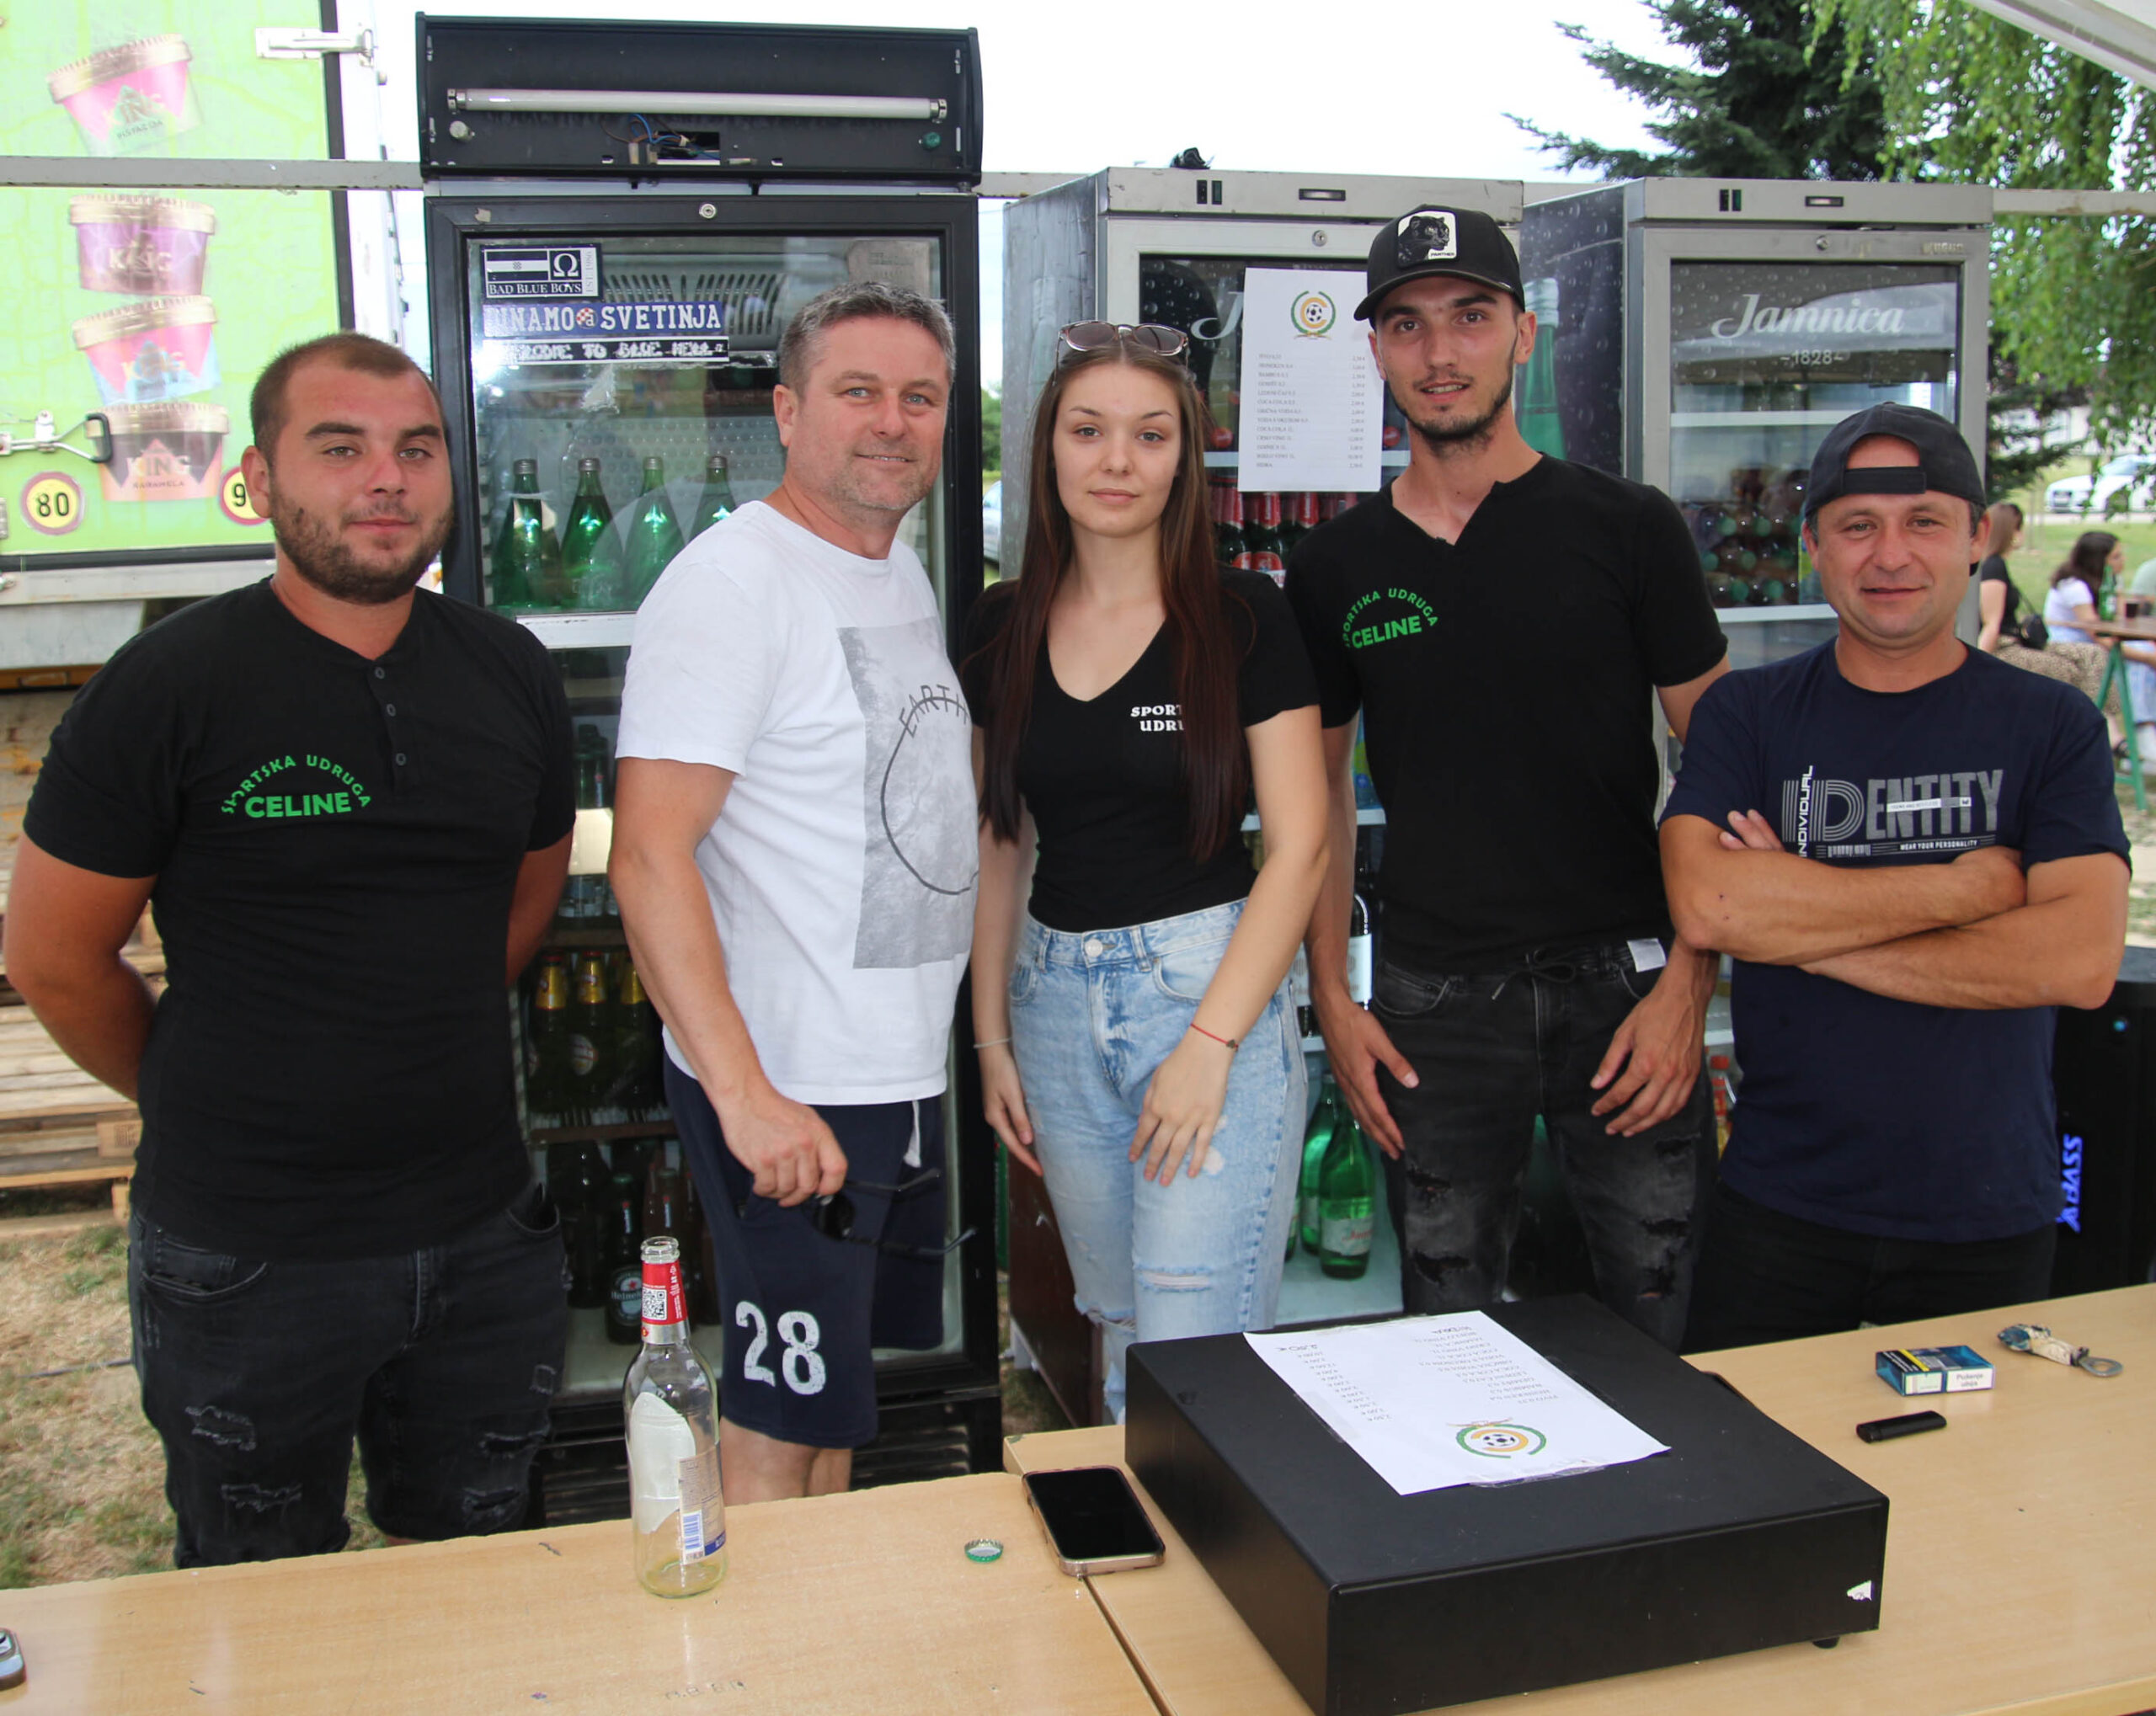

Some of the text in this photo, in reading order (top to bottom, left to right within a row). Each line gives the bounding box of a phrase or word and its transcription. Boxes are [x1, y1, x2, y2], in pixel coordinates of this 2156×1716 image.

[488, 282, 582, 294] BAD BLUE BOYS
[486, 304, 722, 332] DINAMO SVETINJA
[1710, 294, 1906, 339] Jamnica
[36, 491, 71, 518] 80
[233, 483, 247, 507] 9
[1387, 588, 1438, 626] UDRUGA
[1352, 615, 1422, 649] CELINE
[306, 754, 371, 807] UDRUGA
[244, 792, 352, 818] CELINE
[1798, 765, 1813, 858] INDIVIDUAL
[1935, 840, 1977, 849] PERSONALITY
[735, 1301, 826, 1395] 28
